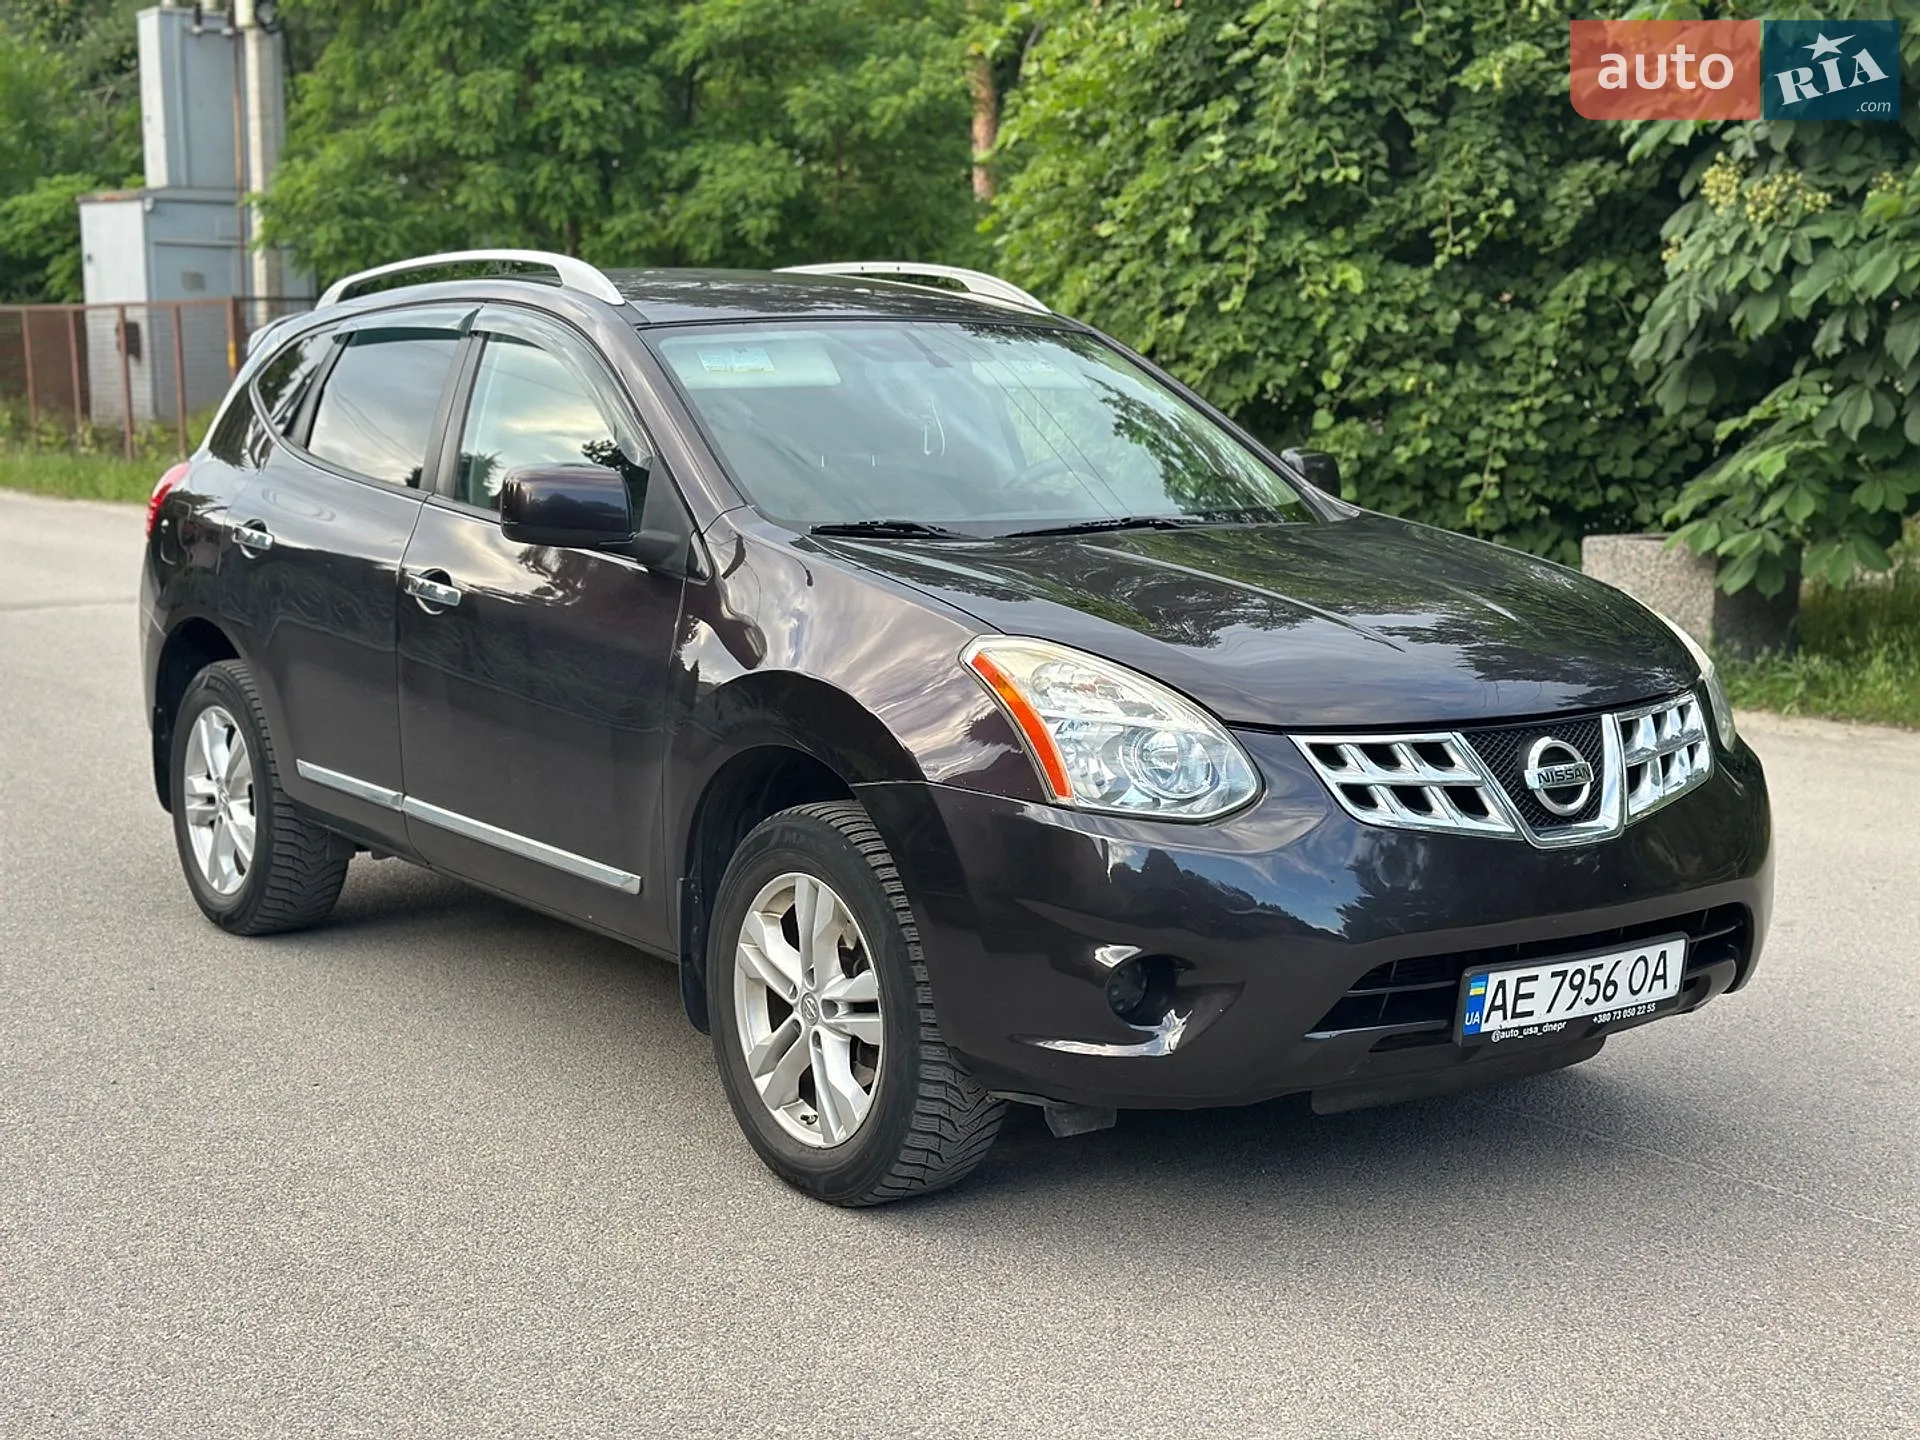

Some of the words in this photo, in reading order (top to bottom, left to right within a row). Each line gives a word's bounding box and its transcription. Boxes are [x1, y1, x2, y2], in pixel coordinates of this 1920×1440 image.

[1537, 766, 1590, 783] NISSAN
[1484, 974, 1539, 1023] AE
[1546, 960, 1622, 1014] 7956
[1628, 950, 1668, 996] OA
[1465, 1011, 1480, 1025] UA
[1491, 1021, 1567, 1042] @auto_usa_dnepr
